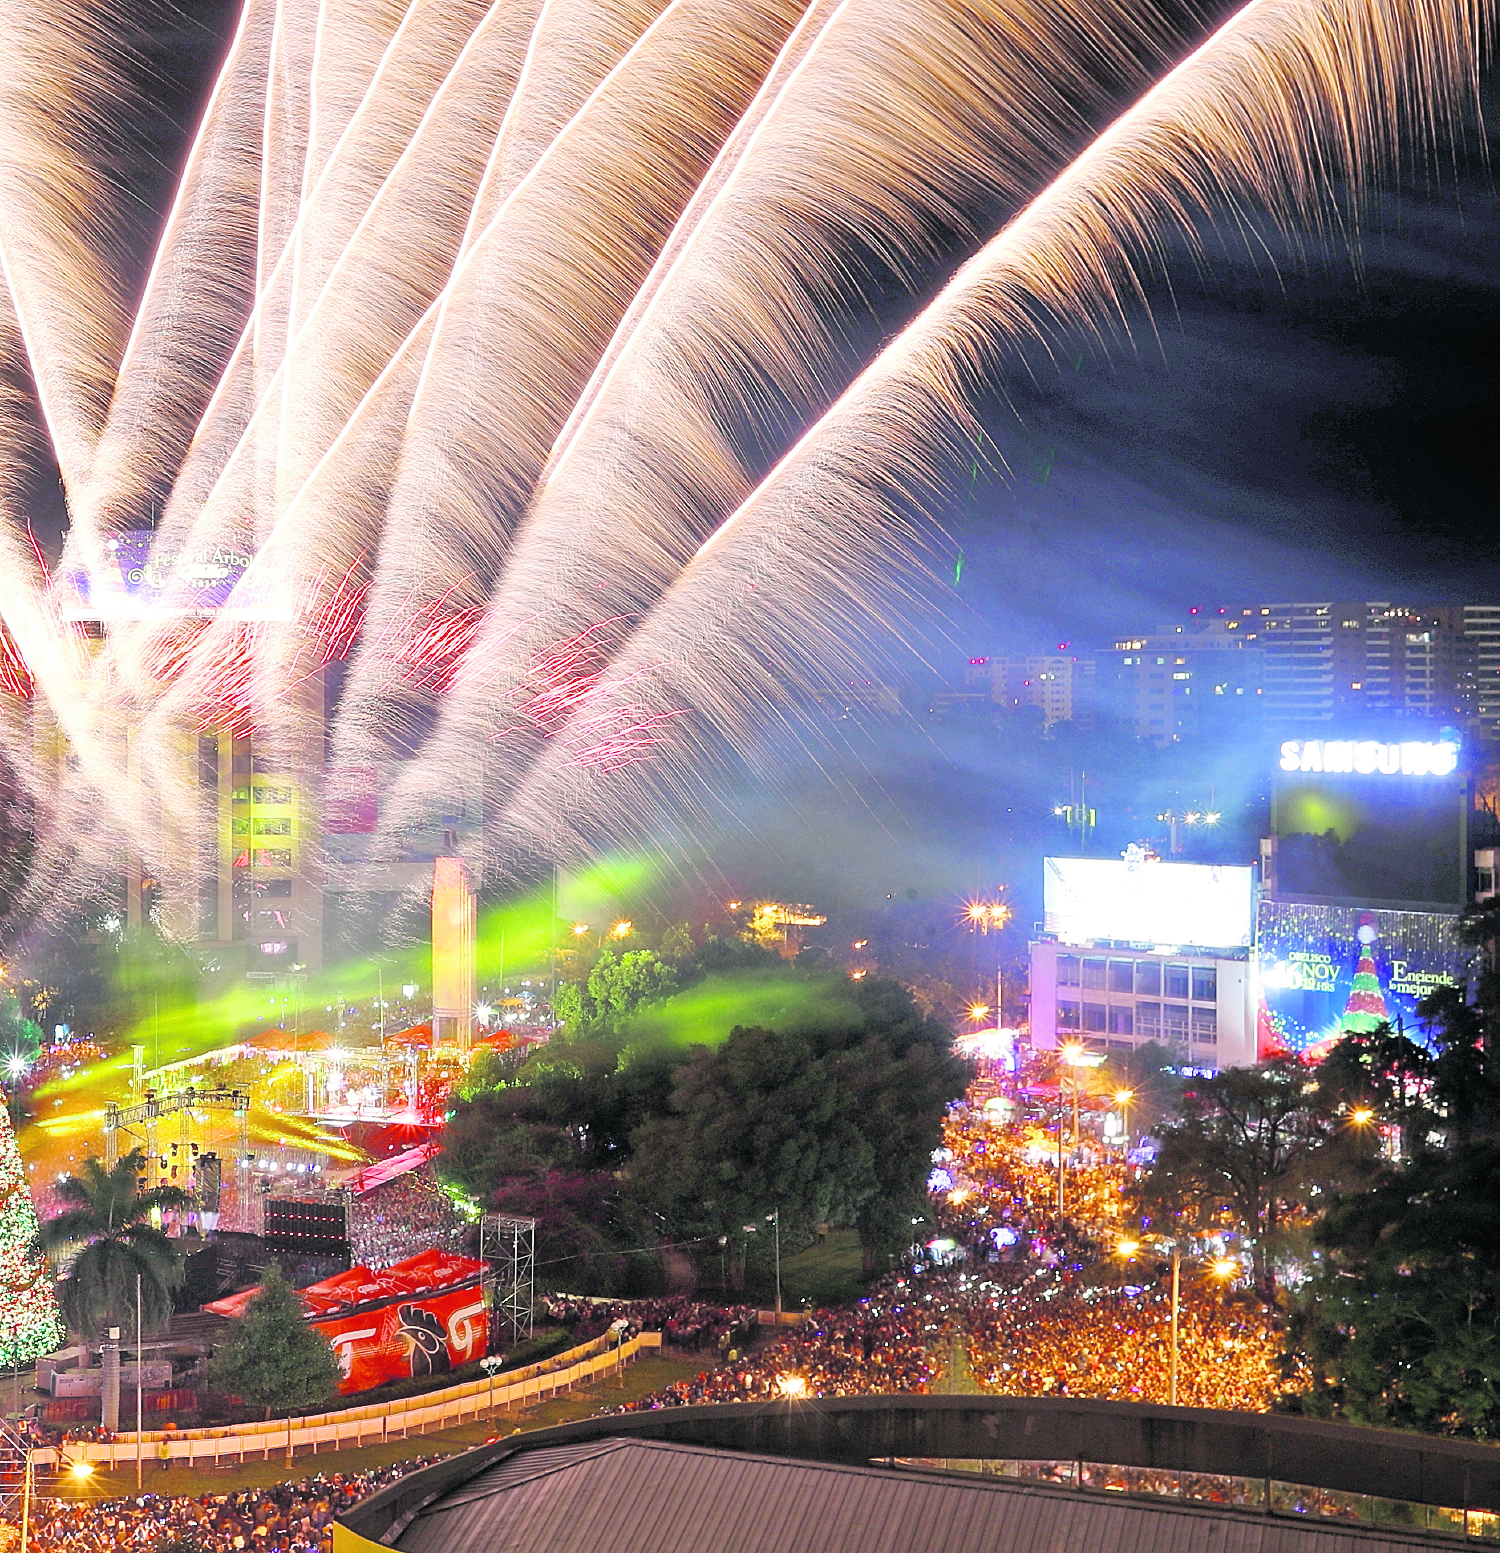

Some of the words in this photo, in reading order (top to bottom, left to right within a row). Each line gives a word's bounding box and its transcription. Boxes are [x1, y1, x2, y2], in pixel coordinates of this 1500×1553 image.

[1279, 740, 1458, 776] SAMSUNG
[1288, 951, 1332, 963] OBELISCO
[1302, 962, 1341, 982] NOV
[1391, 960, 1454, 985] Enciende
[1316, 981, 1336, 993] HRS
[1396, 982, 1435, 999] mejor
